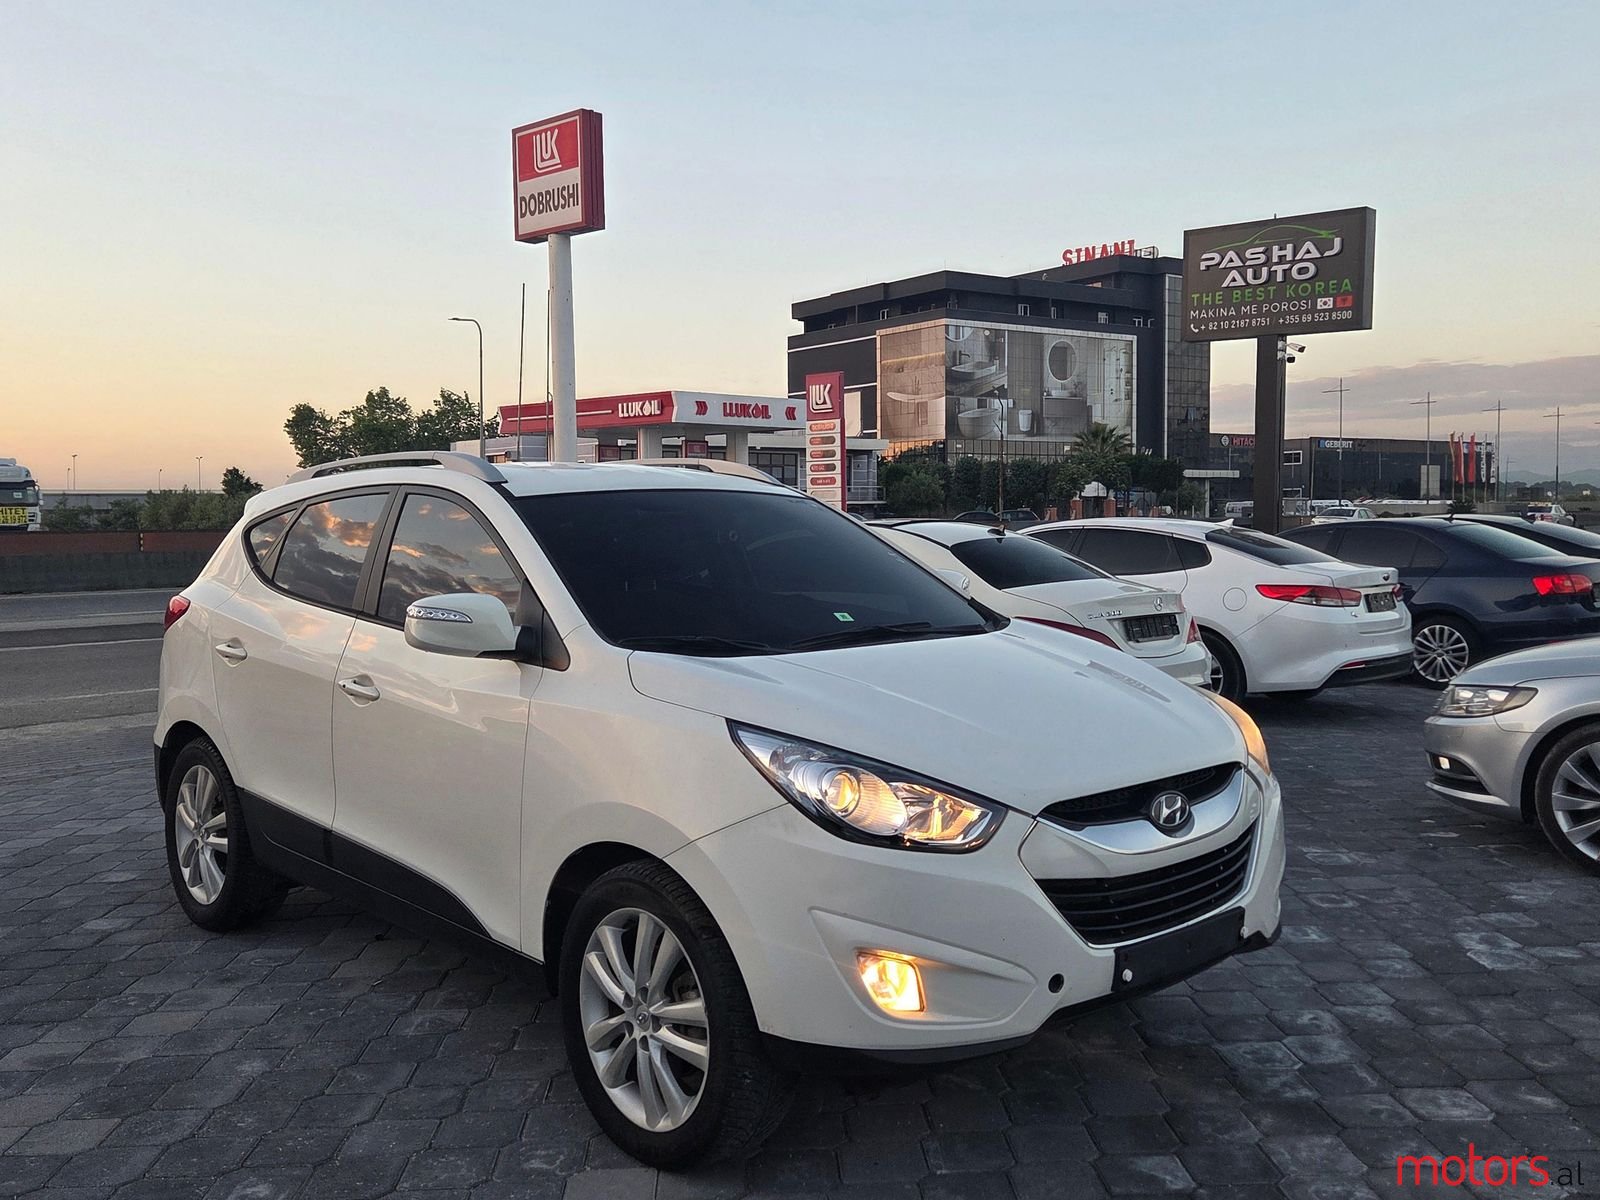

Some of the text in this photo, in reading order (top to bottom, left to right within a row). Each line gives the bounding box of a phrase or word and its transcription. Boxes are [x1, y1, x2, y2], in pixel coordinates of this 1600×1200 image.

[519, 182, 579, 219] DOBRUSHI
[1062, 239, 1135, 266] SINANI
[1200, 237, 1343, 271] PASHAJ
[1221, 261, 1317, 288] AUTO
[1191, 278, 1353, 307] THE BEST KOREA
[1190, 299, 1312, 320] MAKINA ME POROSI
[1220, 320, 1229, 329] 10
[1231, 318, 1250, 329] 2187
[1278, 314, 1300, 325] +355
[1314, 312, 1330, 322] 523
[1331, 310, 1353, 320] 8500
